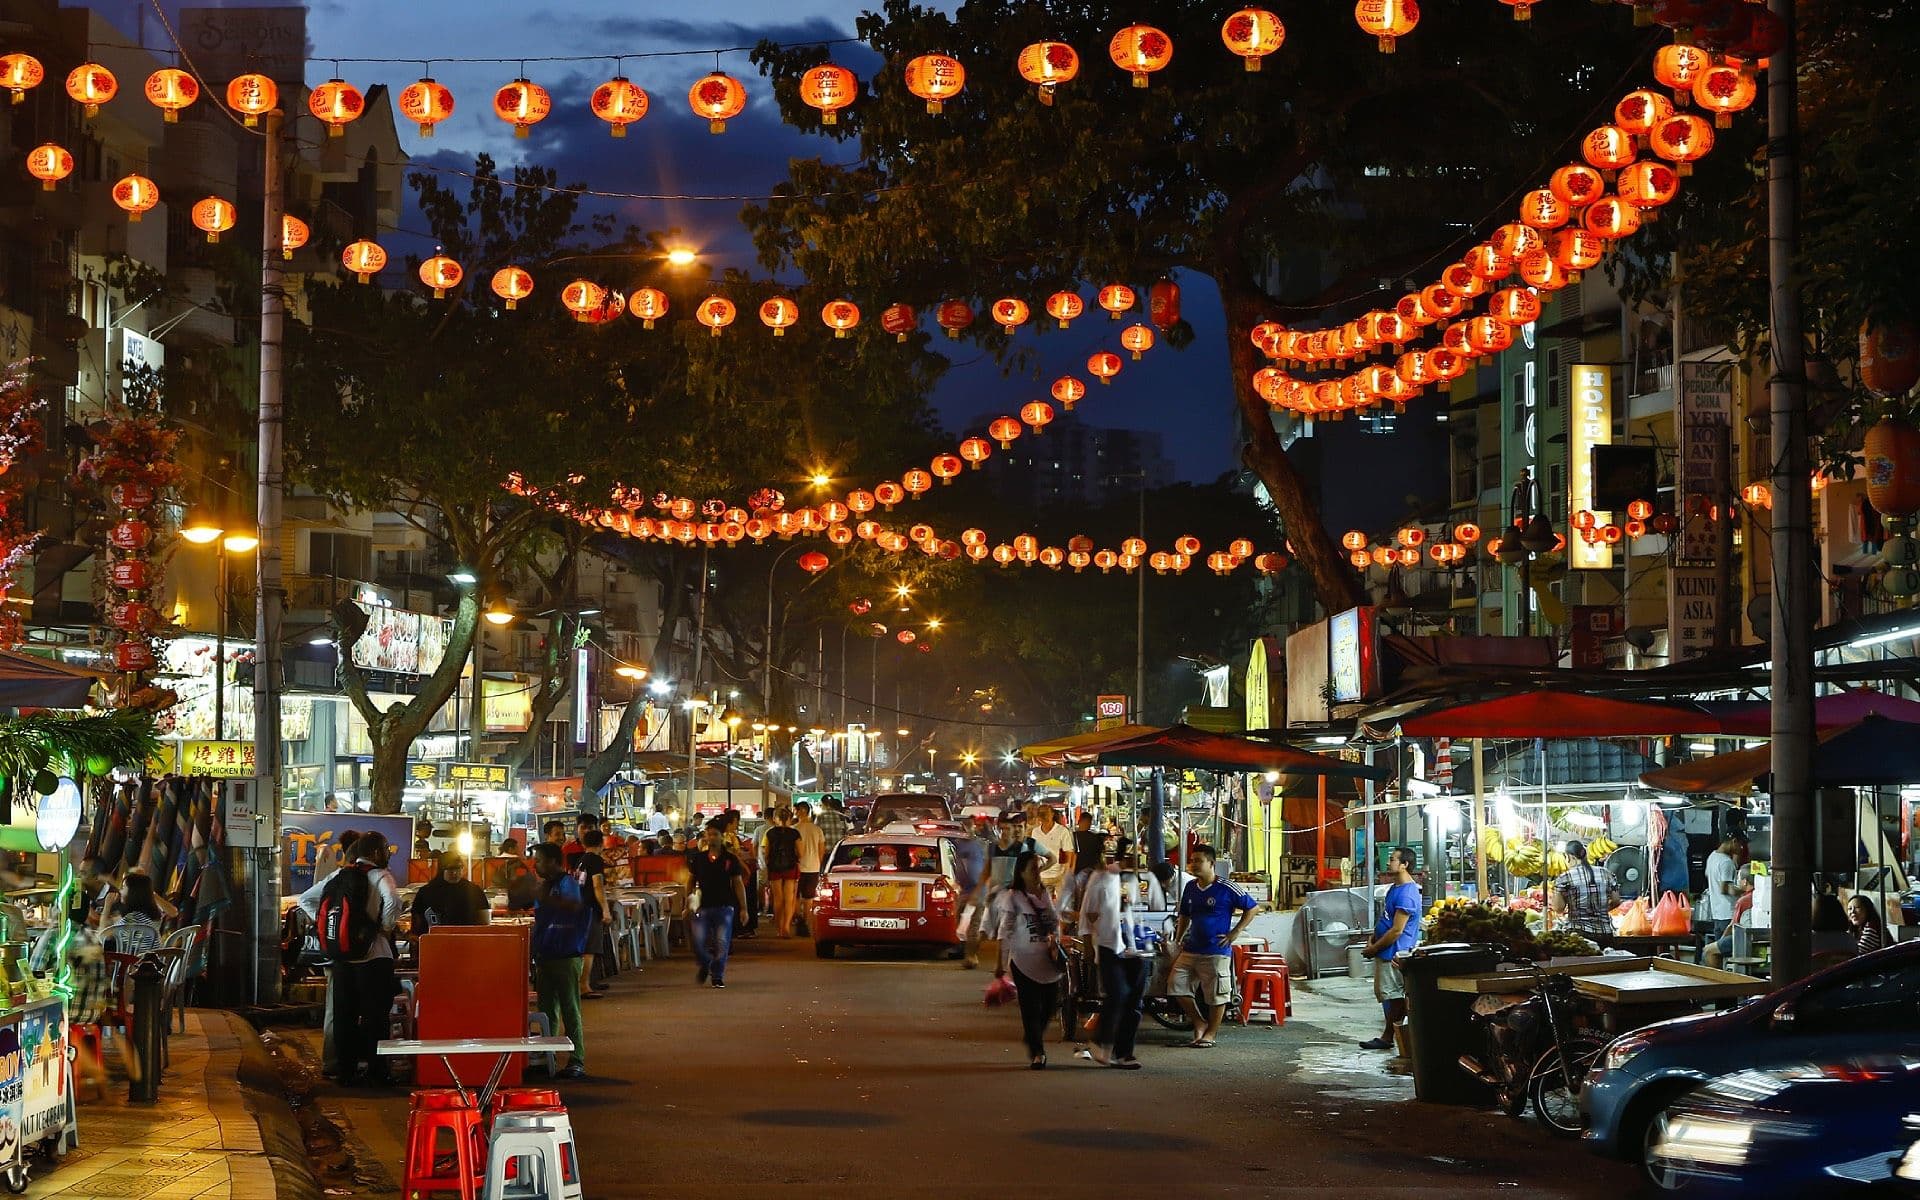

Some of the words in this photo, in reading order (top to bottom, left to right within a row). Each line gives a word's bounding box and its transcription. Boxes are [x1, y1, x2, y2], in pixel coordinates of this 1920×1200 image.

[814, 70, 840, 79] LOONG
[1689, 411, 1728, 427] YEW
[1683, 602, 1713, 620] ASIA
